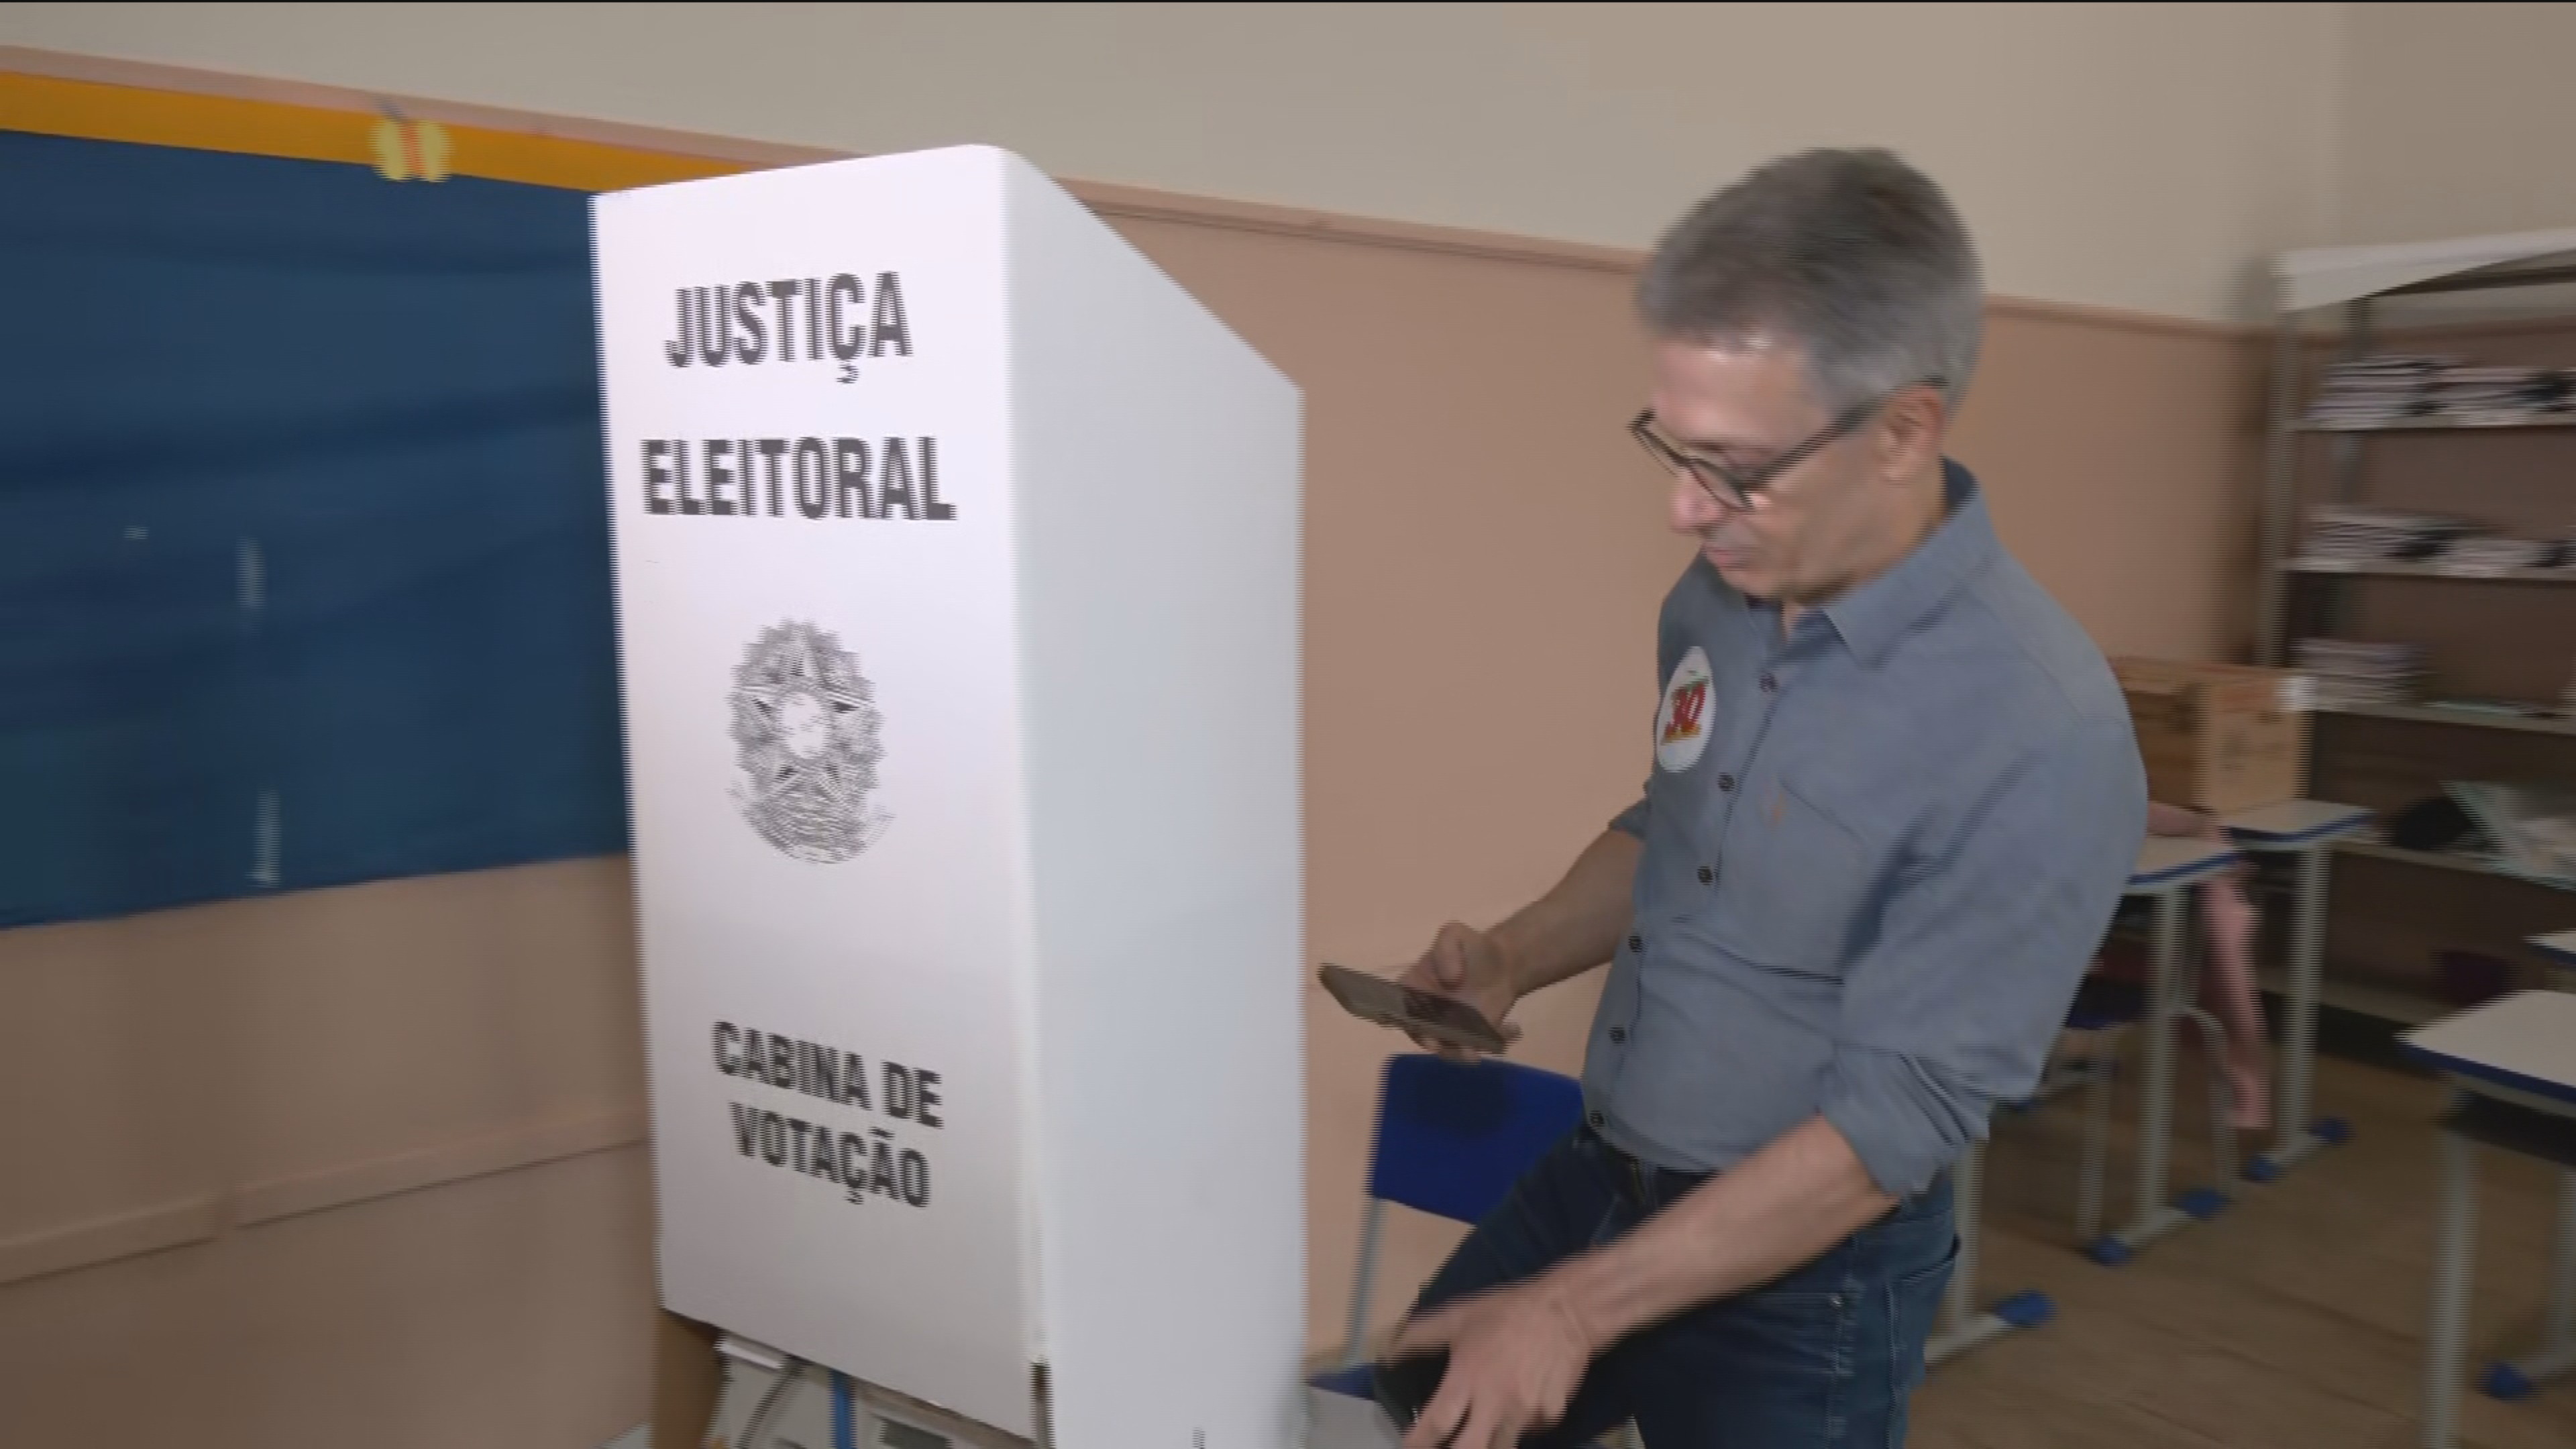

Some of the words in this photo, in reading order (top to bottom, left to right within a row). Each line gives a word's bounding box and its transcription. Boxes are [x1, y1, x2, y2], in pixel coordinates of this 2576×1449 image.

[664, 271, 911, 383] JUSTIÇA
[641, 436, 957, 521] ELEITORAL
[1664, 682, 1707, 738] 30
[712, 1020, 872, 1110] CABINA
[881, 1060, 943, 1128] DE
[731, 1102, 931, 1208] VOTAÇÃO
